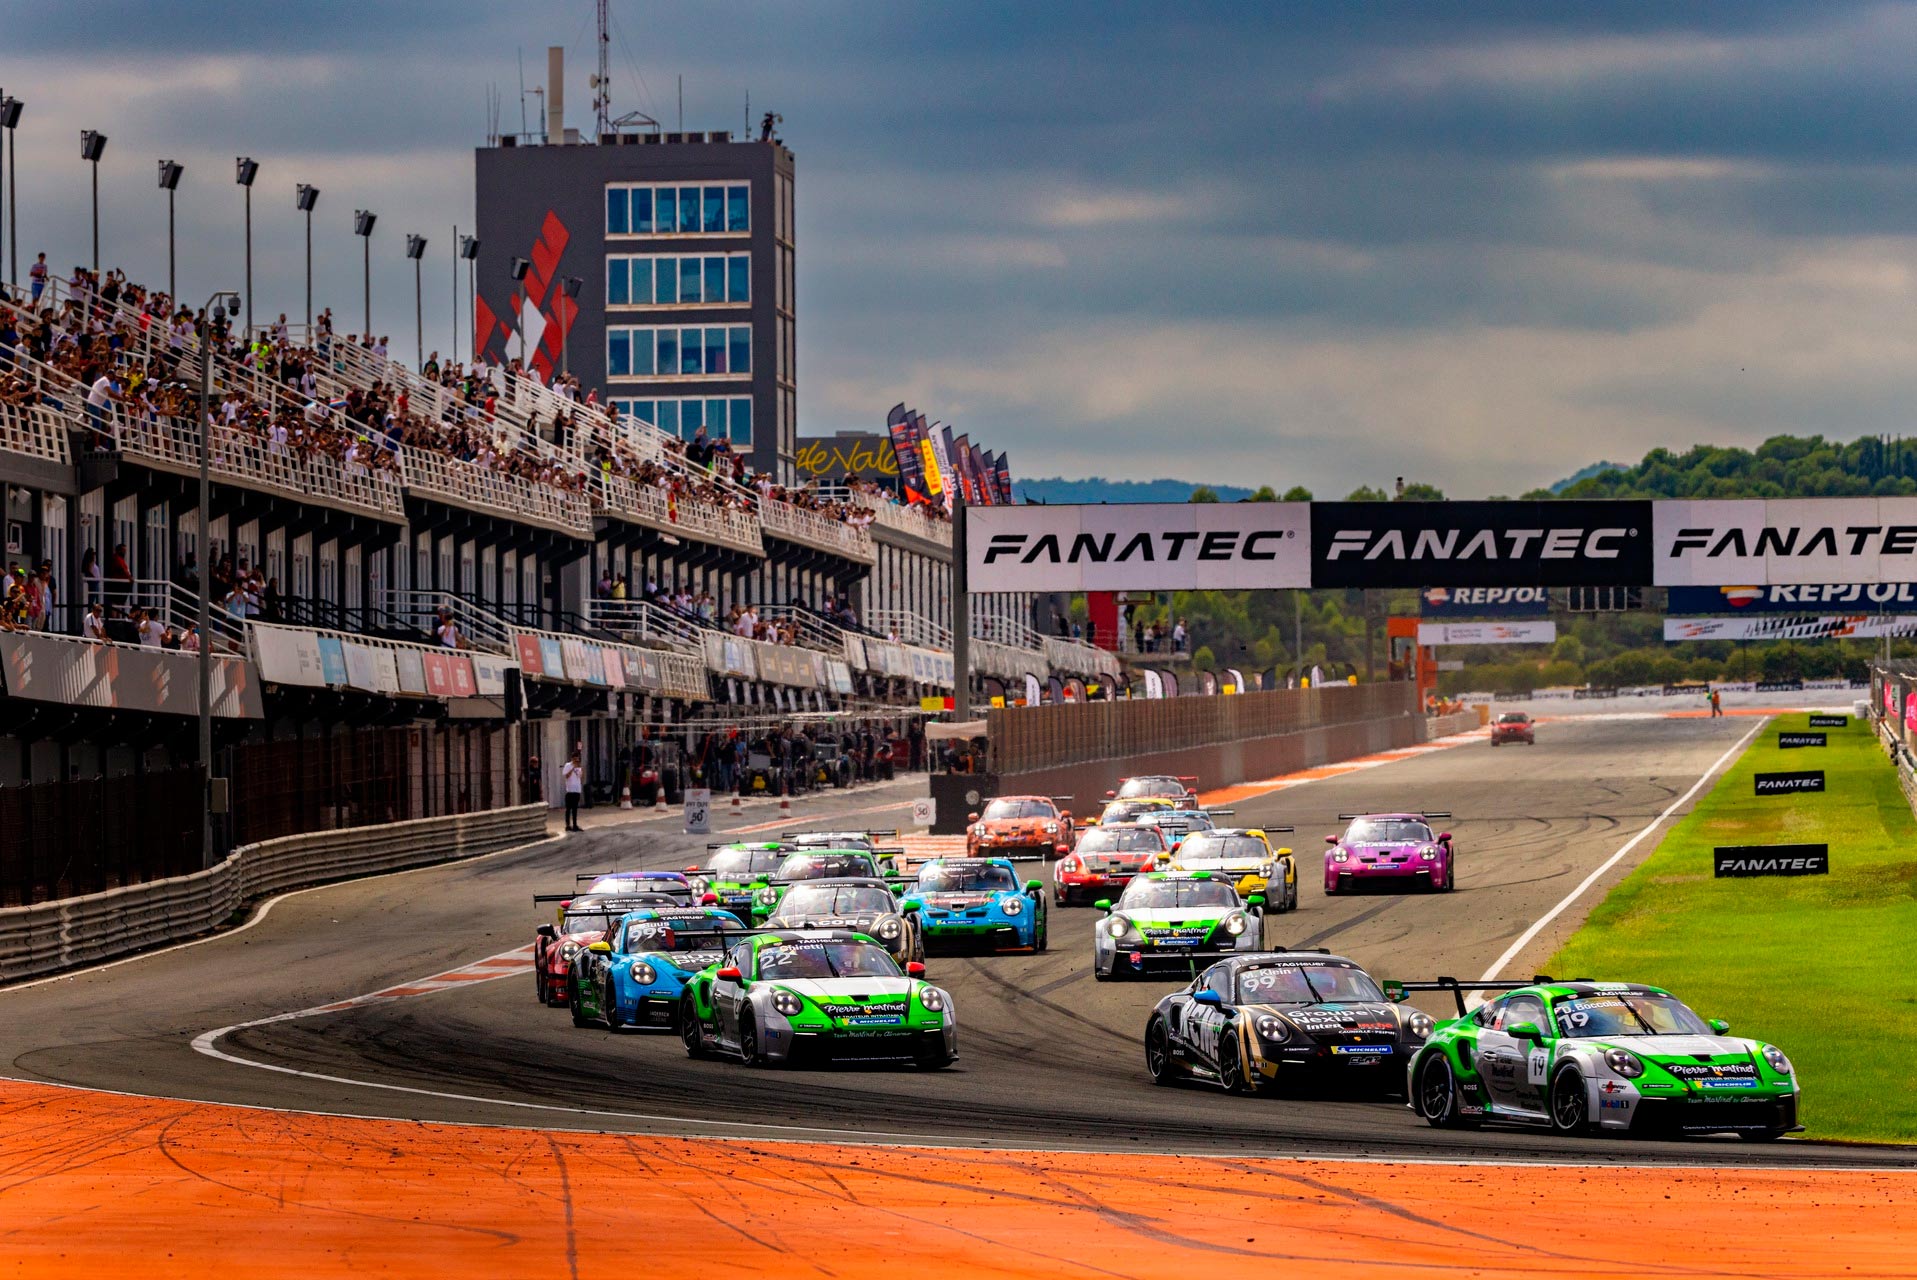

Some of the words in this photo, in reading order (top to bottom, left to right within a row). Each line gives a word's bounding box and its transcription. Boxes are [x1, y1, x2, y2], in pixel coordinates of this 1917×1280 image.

[1453, 587, 1546, 604] REPSOL
[1757, 779, 1821, 789] FANATEC
[1720, 858, 1820, 871] FANATEC
[762, 953, 792, 970] 22
[1261, 968, 1292, 977] Klein
[1244, 975, 1276, 993] 99
[823, 1004, 860, 1012] Pierre
[1287, 1010, 1369, 1019] Groupe
[1292, 1016, 1355, 1025] Nexia
[1559, 1012, 1590, 1031] 19
[1532, 1056, 1545, 1077] 19
[1669, 1065, 1708, 1075] Pierre
